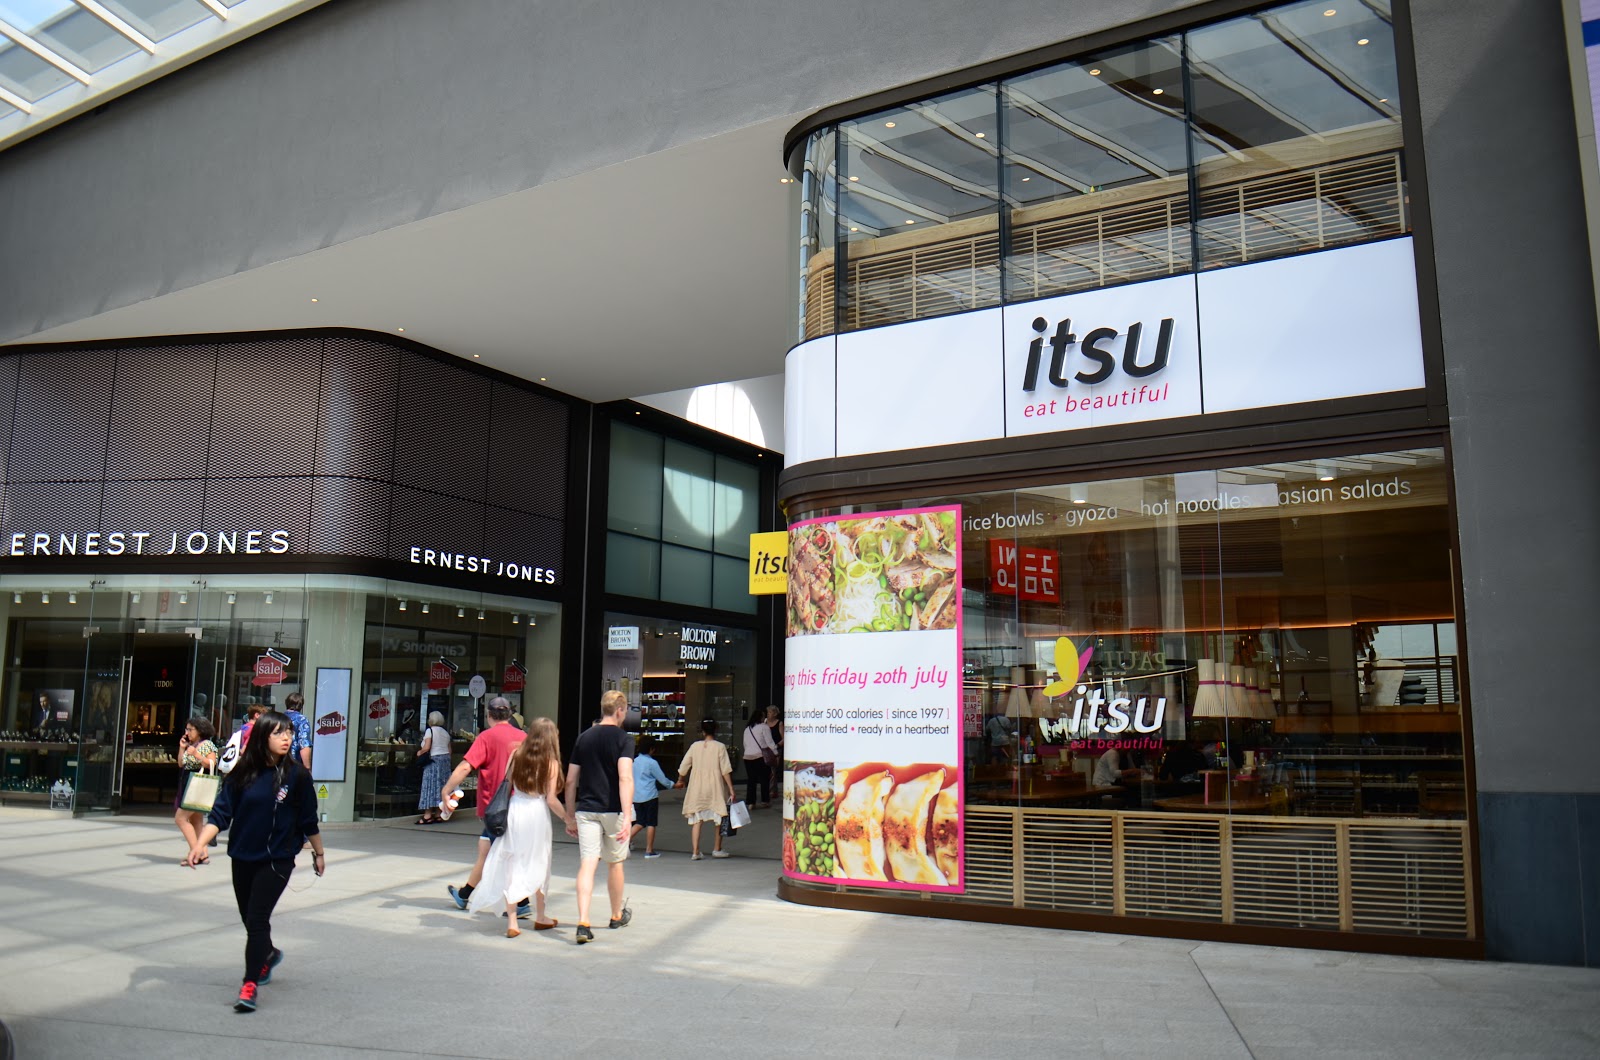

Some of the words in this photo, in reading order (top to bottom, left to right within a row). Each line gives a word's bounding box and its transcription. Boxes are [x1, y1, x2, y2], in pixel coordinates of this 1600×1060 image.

[1022, 316, 1174, 392] itsu
[1023, 399, 1057, 418] eat
[1065, 382, 1169, 413] beautiful
[1065, 504, 1118, 527] gyoza
[1140, 498, 1169, 517] hot
[1175, 491, 1250, 514] noodles
[1278, 485, 1333, 506] asian
[1340, 476, 1412, 501] salads
[10, 531, 150, 557] ERNEST
[167, 529, 290, 556] JONES
[409, 546, 491, 574] ERNEST
[496, 562, 556, 585] JONES
[681, 626, 717, 645] MOLTON
[680, 644, 716, 662] BROWN
[258, 662, 281, 675] sale
[431, 668, 450, 680] sale
[506, 672, 522, 682] sale
[797, 668, 817, 686] this
[821, 666, 868, 689] friday
[873, 665, 907, 684] 20th
[910, 664, 948, 689] july
[154, 680, 174, 688] TUDOR
[801, 708, 823, 719] under
[826, 708, 844, 719] 500
[846, 707, 884, 719] calories
[891, 708, 918, 719] since
[920, 707, 944, 719] 1997
[1072, 685, 1167, 734] itsu
[321, 718, 341, 728] sale
[799, 724, 814, 734] fresh
[815, 724, 827, 734] not
[829, 724, 848, 734] fried
[858, 724, 883, 736] ready
[885, 725, 894, 734] in
[896, 726, 902, 734] a
[904, 724, 950, 735] heartbeat
[1070, 739, 1093, 750] eat
[1097, 736, 1163, 750] beautiful
